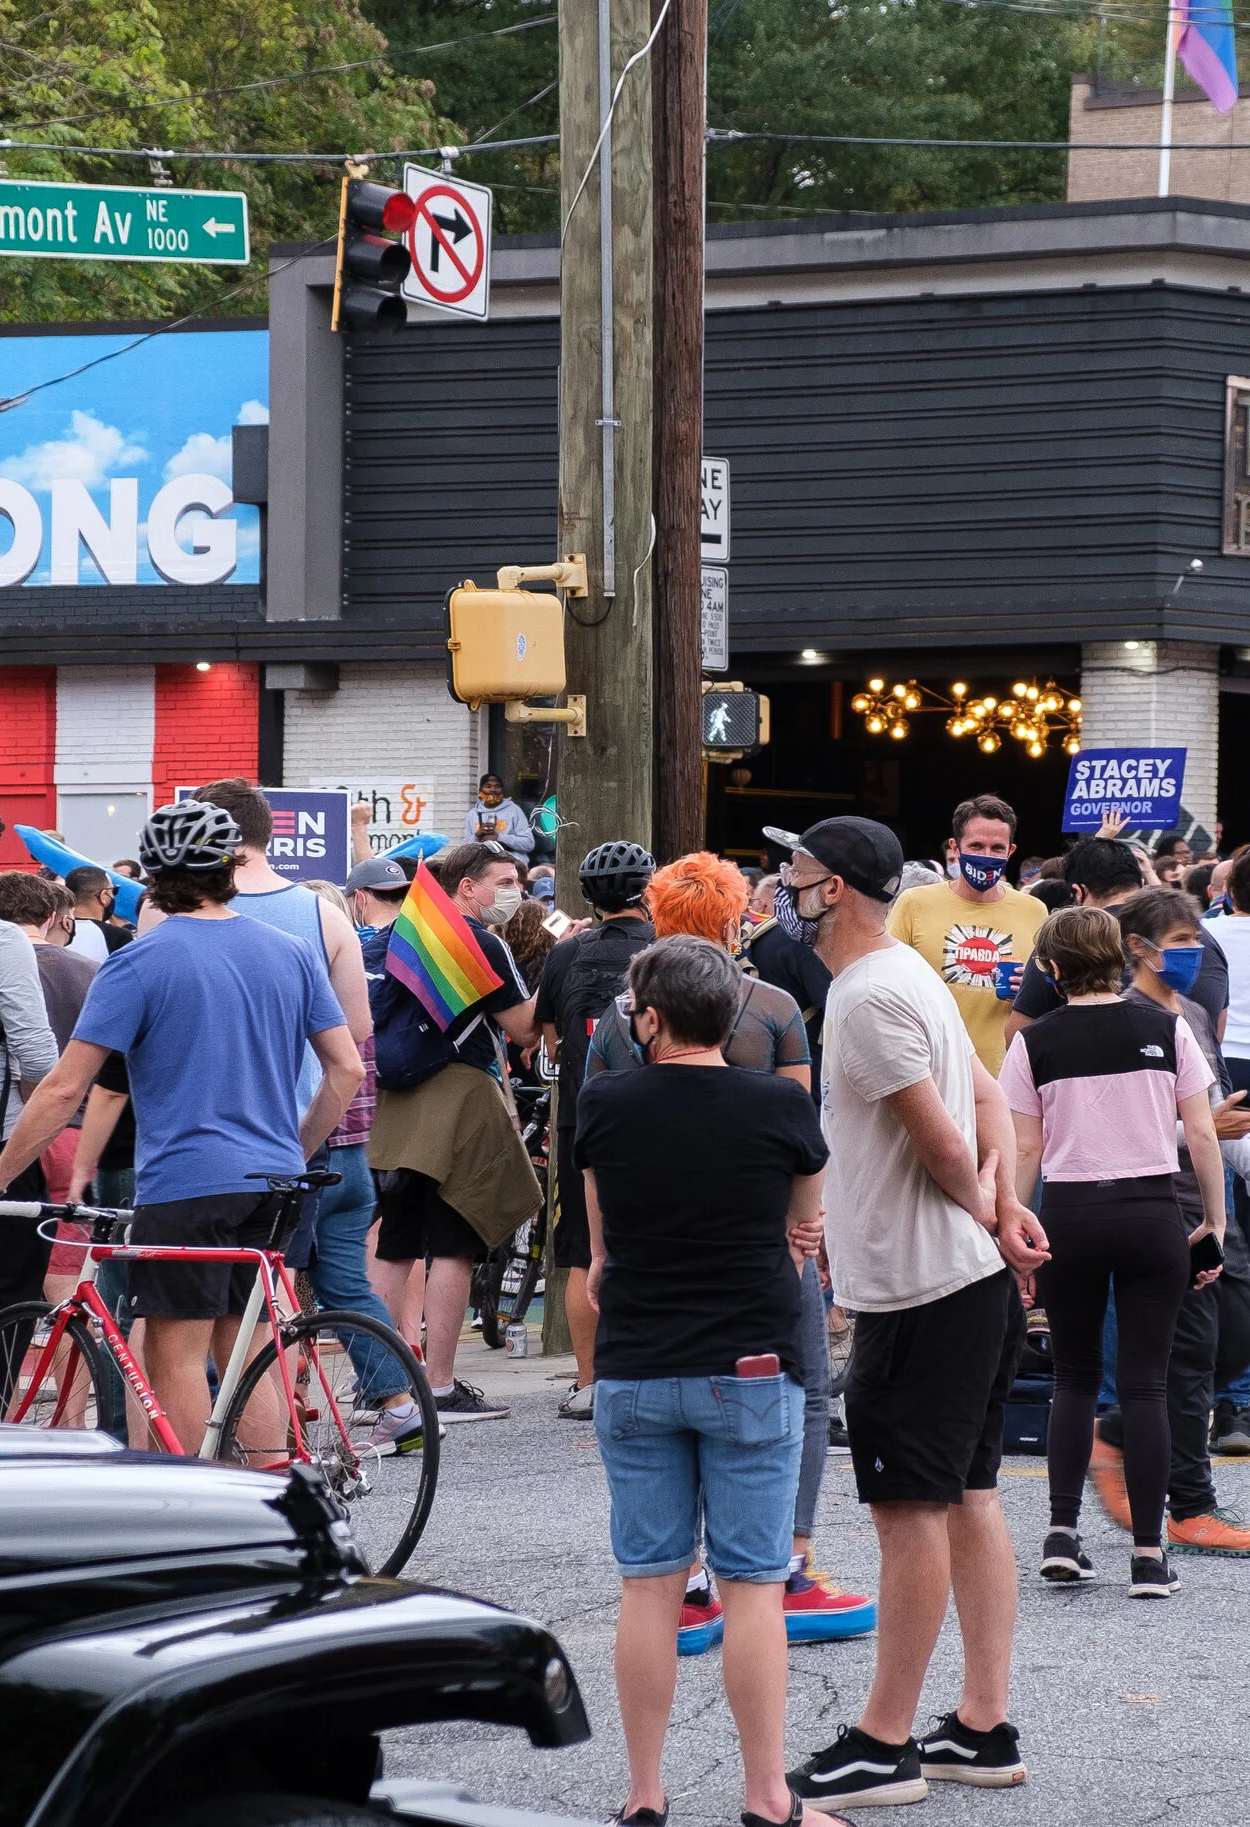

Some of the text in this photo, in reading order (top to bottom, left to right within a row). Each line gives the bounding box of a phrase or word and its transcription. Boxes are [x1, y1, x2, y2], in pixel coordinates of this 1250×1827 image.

[94, 200, 132, 245] Av
[145, 200, 168, 223] NE
[147, 227, 189, 252] 1000
[701, 498, 722, 520] AY
[707, 601, 724, 612] 4AM
[1074, 758, 1173, 780] STACEY
[1071, 778, 1177, 800] ABRAMS
[1070, 800, 1153, 816] GOVERNOR
[965, 862, 1002, 882] BIDEN
[107, 1334, 159, 1420] CENTURION
